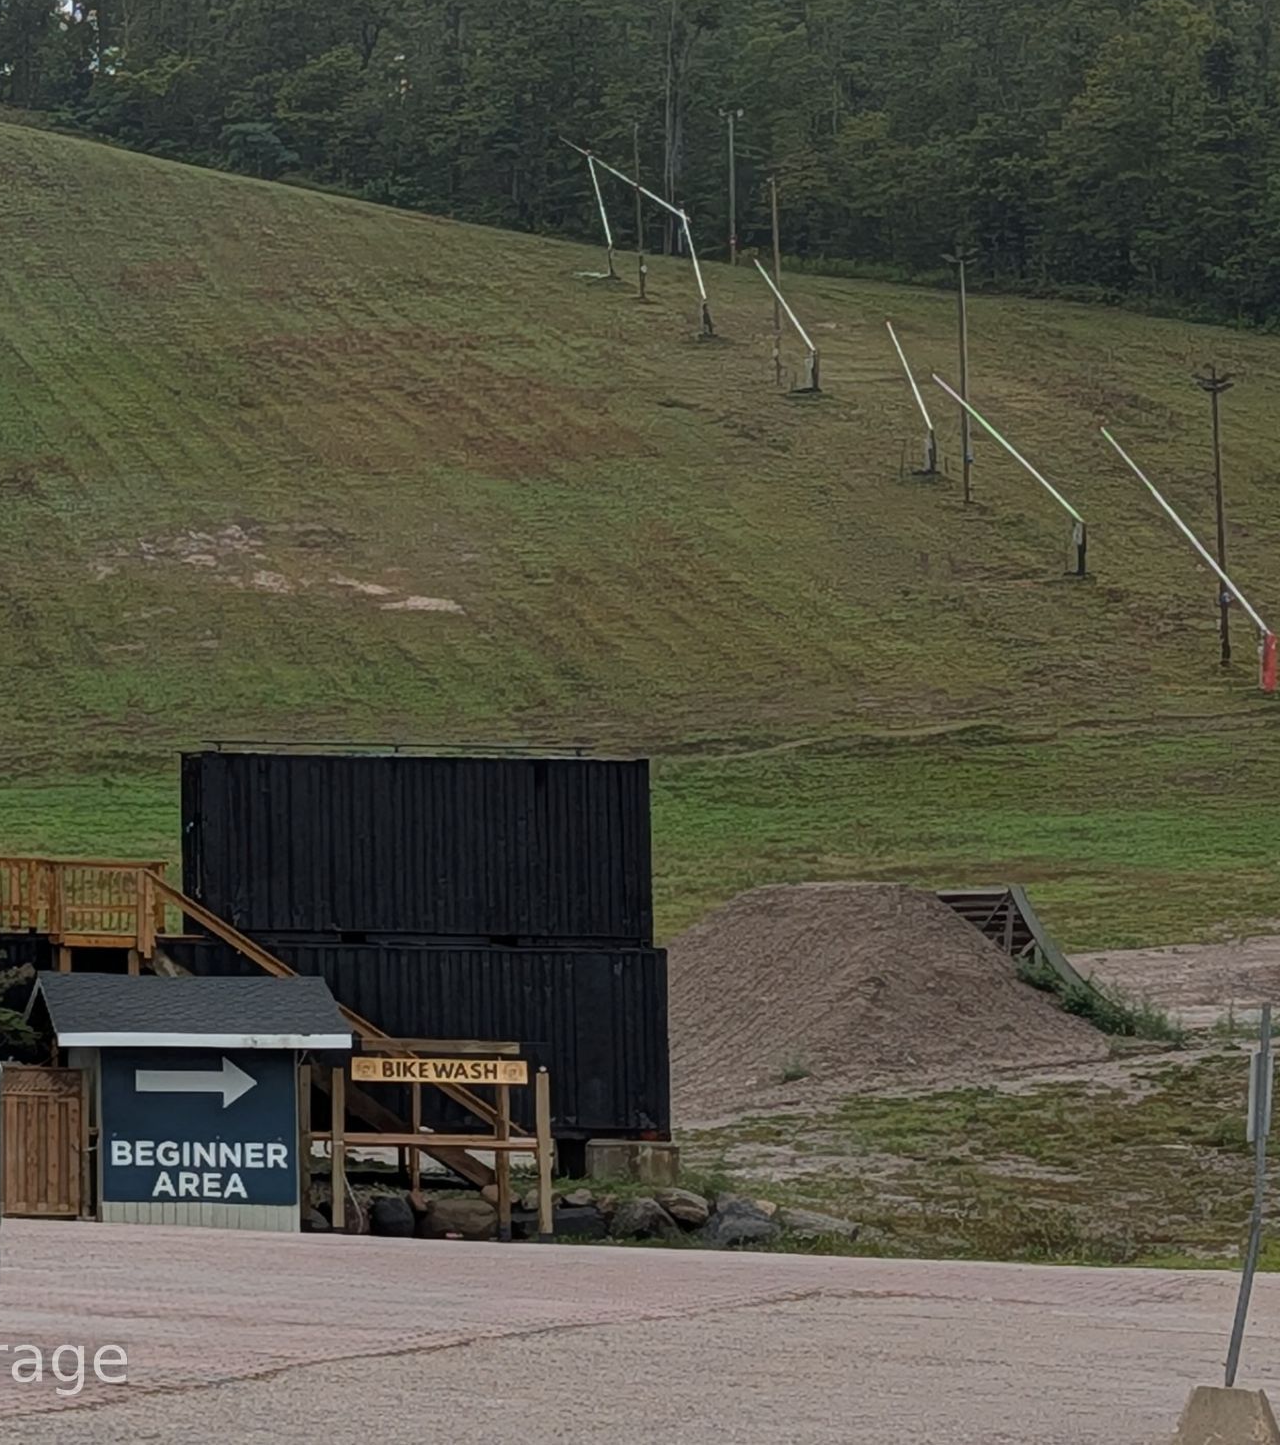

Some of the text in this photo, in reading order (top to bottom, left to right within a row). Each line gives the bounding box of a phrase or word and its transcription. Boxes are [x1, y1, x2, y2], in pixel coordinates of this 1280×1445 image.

[382, 1061, 497, 1079] BIKE WASH
[111, 1140, 288, 1169] BEGINNER
[152, 1171, 248, 1198] AREA
